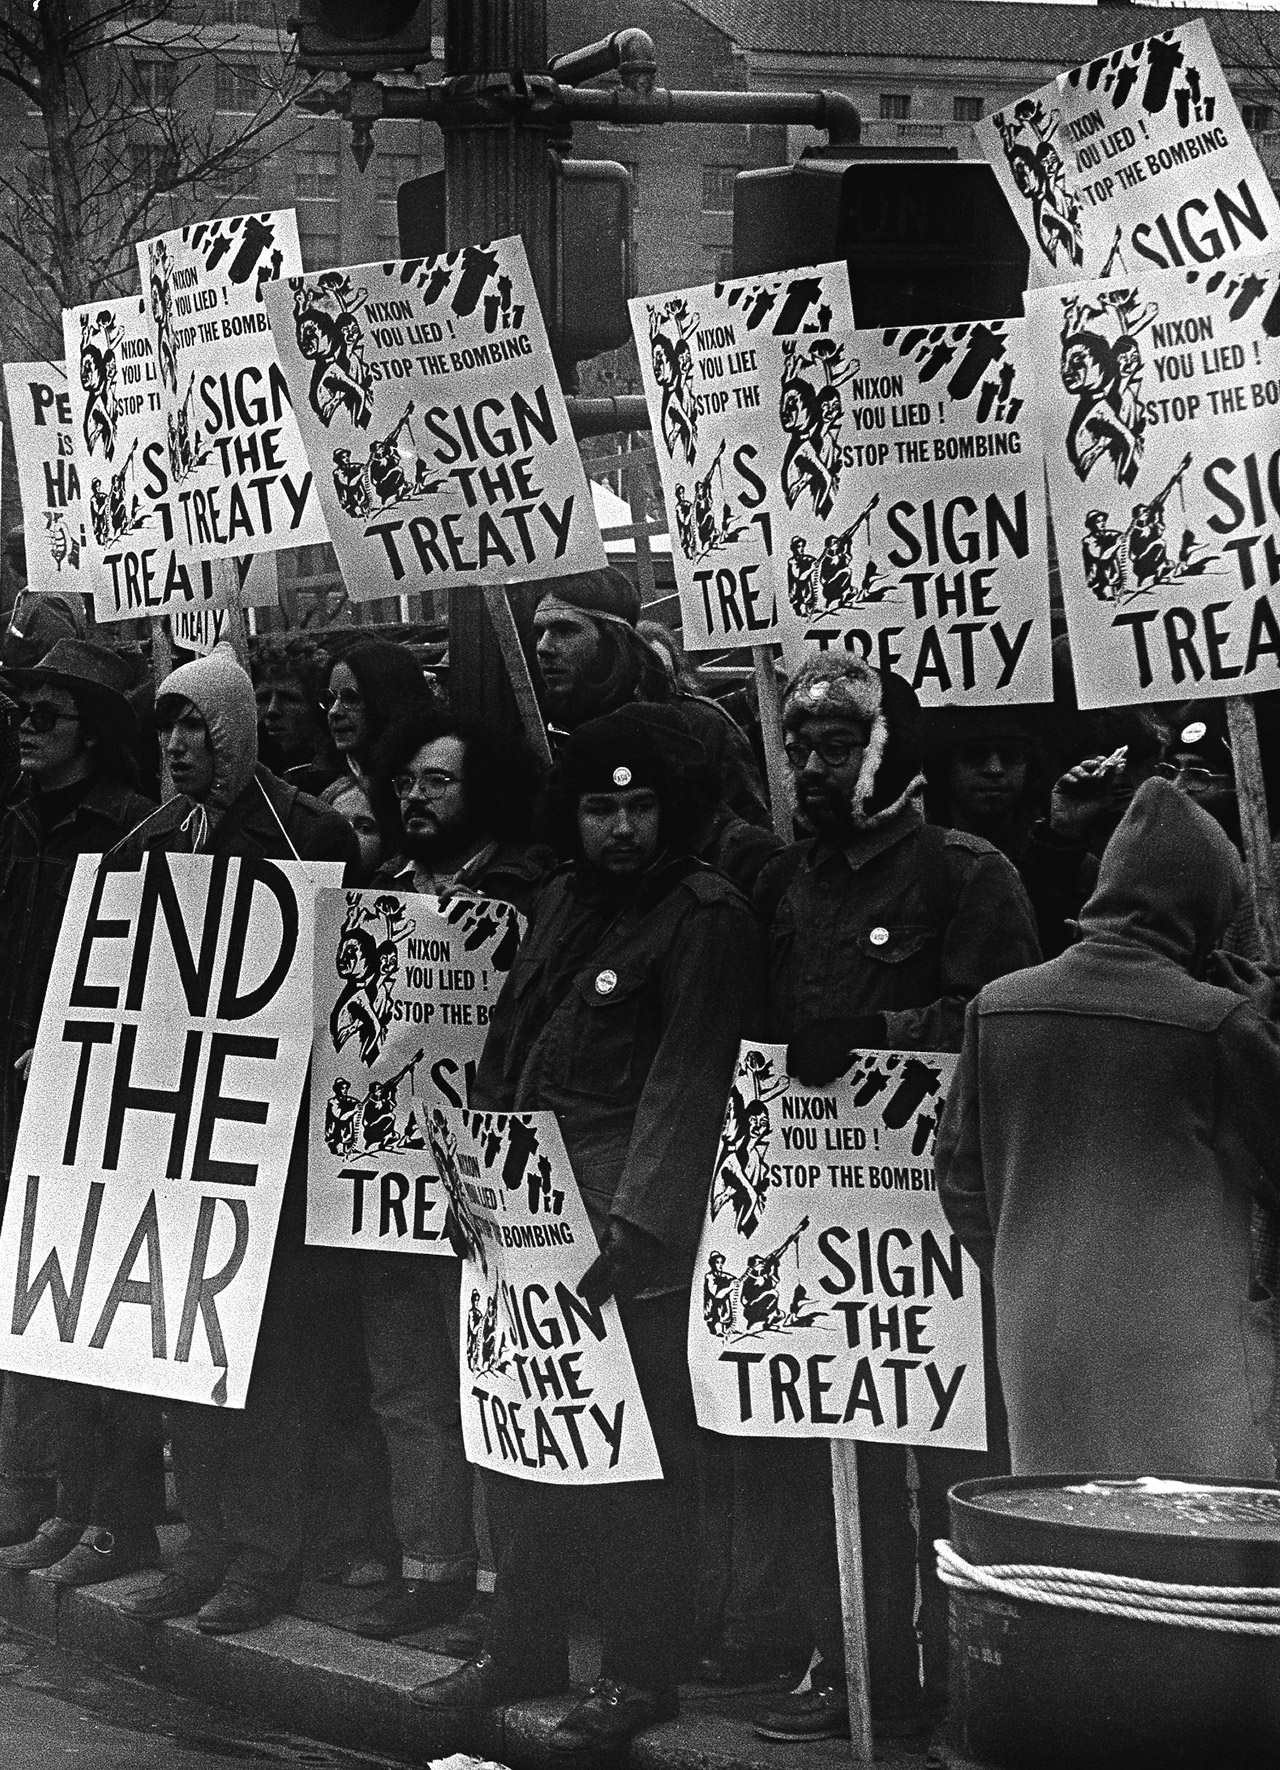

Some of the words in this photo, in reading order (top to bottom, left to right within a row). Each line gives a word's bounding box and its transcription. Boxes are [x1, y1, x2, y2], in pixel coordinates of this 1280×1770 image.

[1100, 126, 1136, 159] LIED
[1114, 160, 1148, 190] THE
[1144, 127, 1229, 176] BOMBING
[1131, 178, 1269, 270] SIGN
[172, 265, 199, 291] NIXON
[174, 295, 192, 317] YOU
[192, 288, 218, 313] LIED
[364, 300, 414, 324] NIXON
[175, 326, 197, 350] STOP
[197, 320, 220, 344] THE
[370, 327, 405, 350] YOU
[407, 321, 444, 346] LIED
[696, 324, 736, 352] NIXON
[1151, 315, 1214, 349] NIXON
[121, 363, 142, 385] YOU
[369, 357, 414, 383] STOP
[415, 351, 451, 376] THE
[453, 334, 533, 373] BOMBING
[698, 355, 724, 380] YOU
[1154, 352, 1194, 383] YOU
[1201, 344, 1246, 375] LIED
[27, 382, 73, 427] PE
[118, 395, 144, 417] STOP
[696, 391, 729, 416] STOP
[852, 375, 904, 401] NIXON
[1146, 394, 1200, 426] STOP
[1206, 386, 1248, 415] THE
[424, 384, 559, 466] SIGN
[852, 407, 886, 431] YOU
[892, 402, 931, 427] LIED
[213, 427, 288, 478] THE
[843, 442, 890, 468] STOP
[894, 439, 930, 463] THE
[934, 431, 1021, 462] BOMBING
[42, 459, 81, 508] HA
[449, 455, 544, 509] THE
[178, 471, 313, 546] TREATY
[364, 494, 575, 582] TREATY
[886, 490, 1030, 569] SIGN
[692, 564, 779, 636] TRE
[899, 567, 1002, 620] THE
[1111, 594, 1280, 689] TREA
[68, 850, 300, 1021] END
[407, 938, 451, 962] NIXON
[406, 966, 434, 990] YOU
[439, 969, 475, 991] LIED
[393, 1000, 435, 1025] STOP
[439, 1003, 473, 1025] THE
[62, 1020, 280, 1187] THE
[781, 1096, 838, 1120] NIXON
[782, 1126, 819, 1151] YOU
[825, 1127, 867, 1151] LIED
[770, 1165, 822, 1189] STOP
[830, 1165, 866, 1189] THE
[501, 1222, 575, 1249] BOMBING
[10, 1175, 250, 1368] WAR
[817, 1225, 964, 1301] SIGN
[501, 1280, 608, 1351] SIGN
[832, 1301, 935, 1355] THE
[512, 1351, 595, 1401] THE
[718, 1350, 967, 1432] TREATY
[471, 1386, 626, 1471] TREATY
